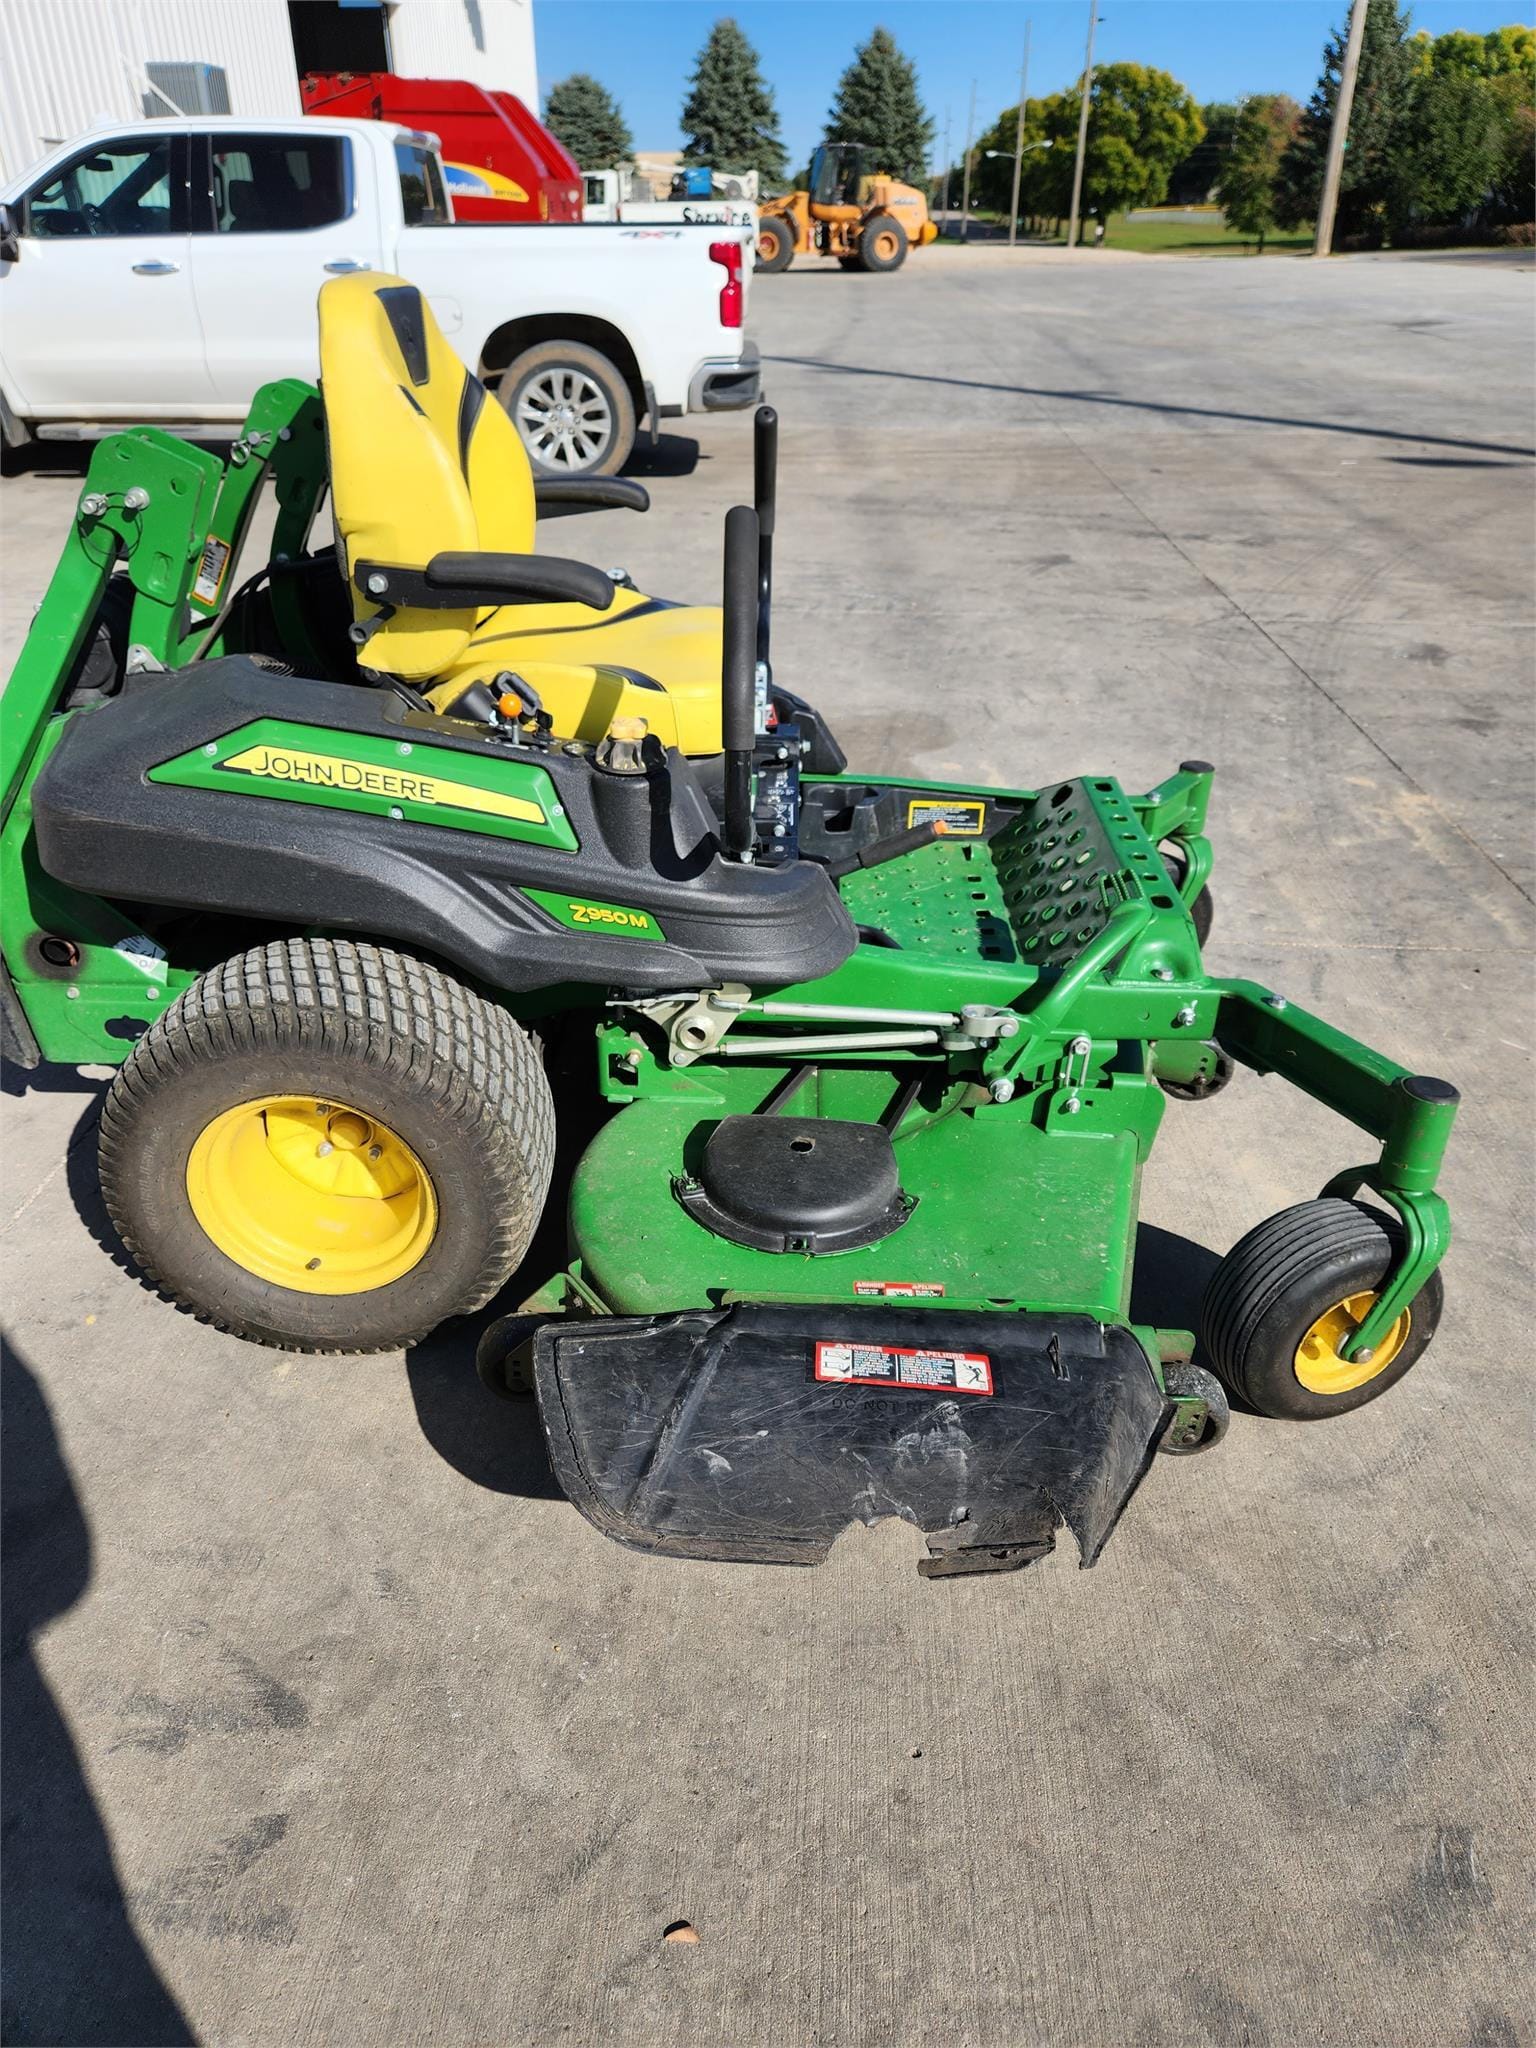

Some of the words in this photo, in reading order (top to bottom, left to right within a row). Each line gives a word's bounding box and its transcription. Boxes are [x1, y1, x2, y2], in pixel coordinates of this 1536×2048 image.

[255, 751, 332, 781] JOHN
[341, 764, 435, 799] DEERE
[568, 903, 649, 929] Z950M
[846, 1343, 883, 1353] DANGER
[925, 1351, 966, 1360] PELIGRO
